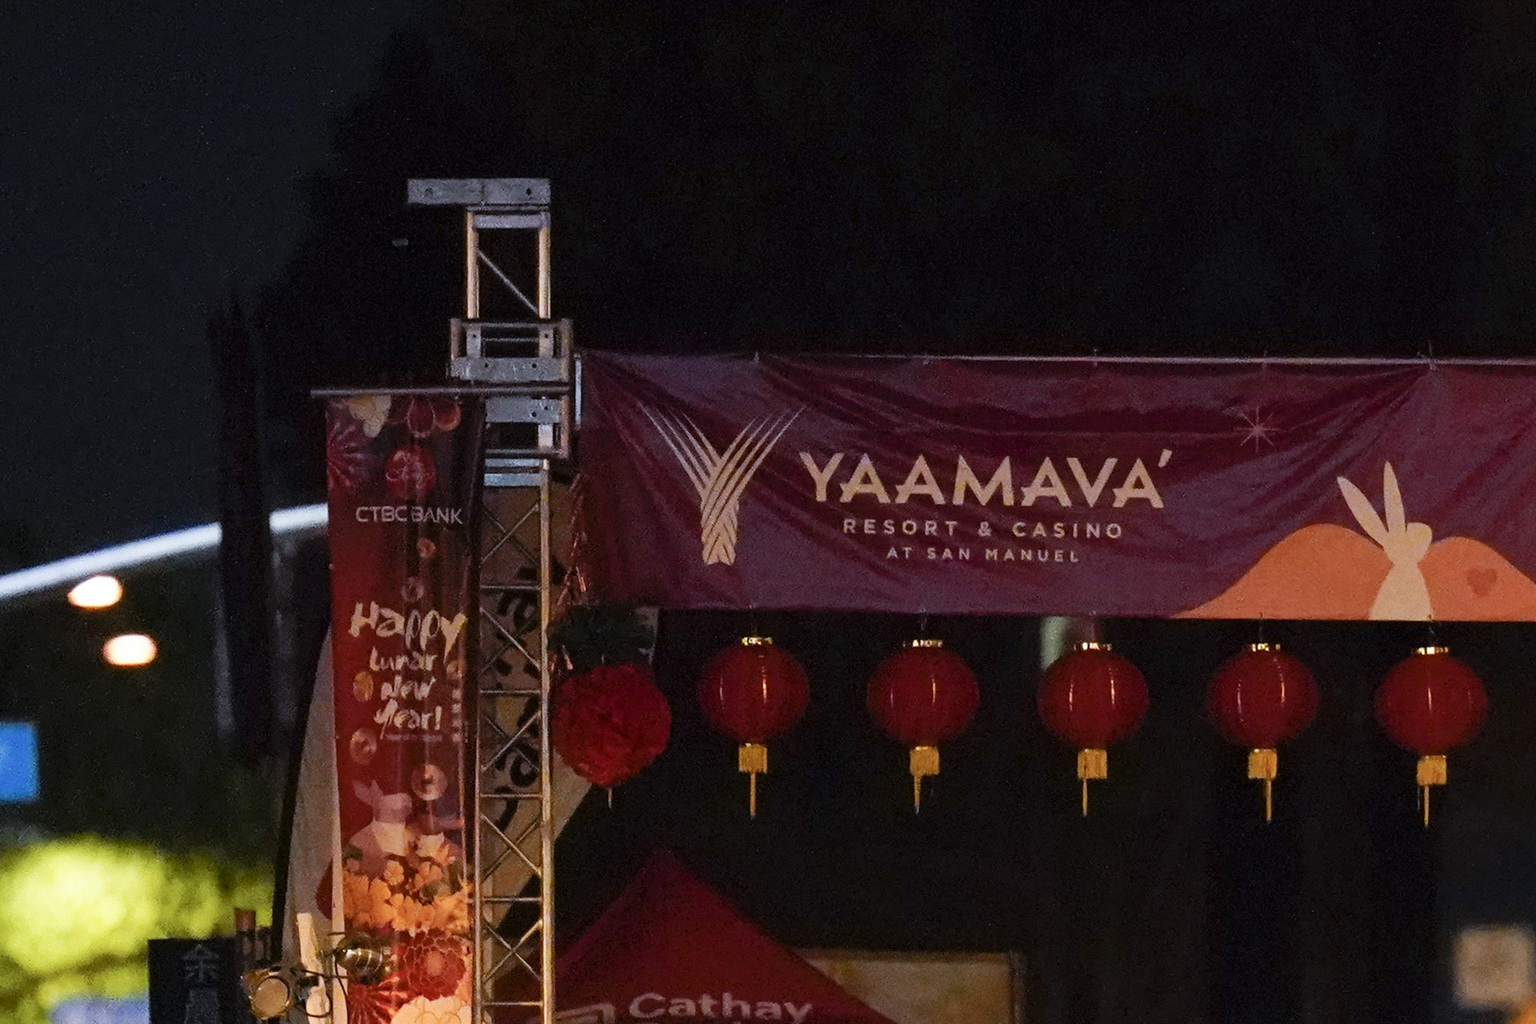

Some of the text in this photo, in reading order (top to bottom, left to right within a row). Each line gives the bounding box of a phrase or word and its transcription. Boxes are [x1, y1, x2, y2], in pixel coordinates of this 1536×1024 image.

[800, 449, 1173, 509] YAAMAVA'
[355, 505, 463, 525] CTBC BANK
[843, 518, 1123, 539] RESORT & CASINO
[887, 546, 1080, 564] AT SAN MANUEL
[348, 600, 468, 666] Happy
